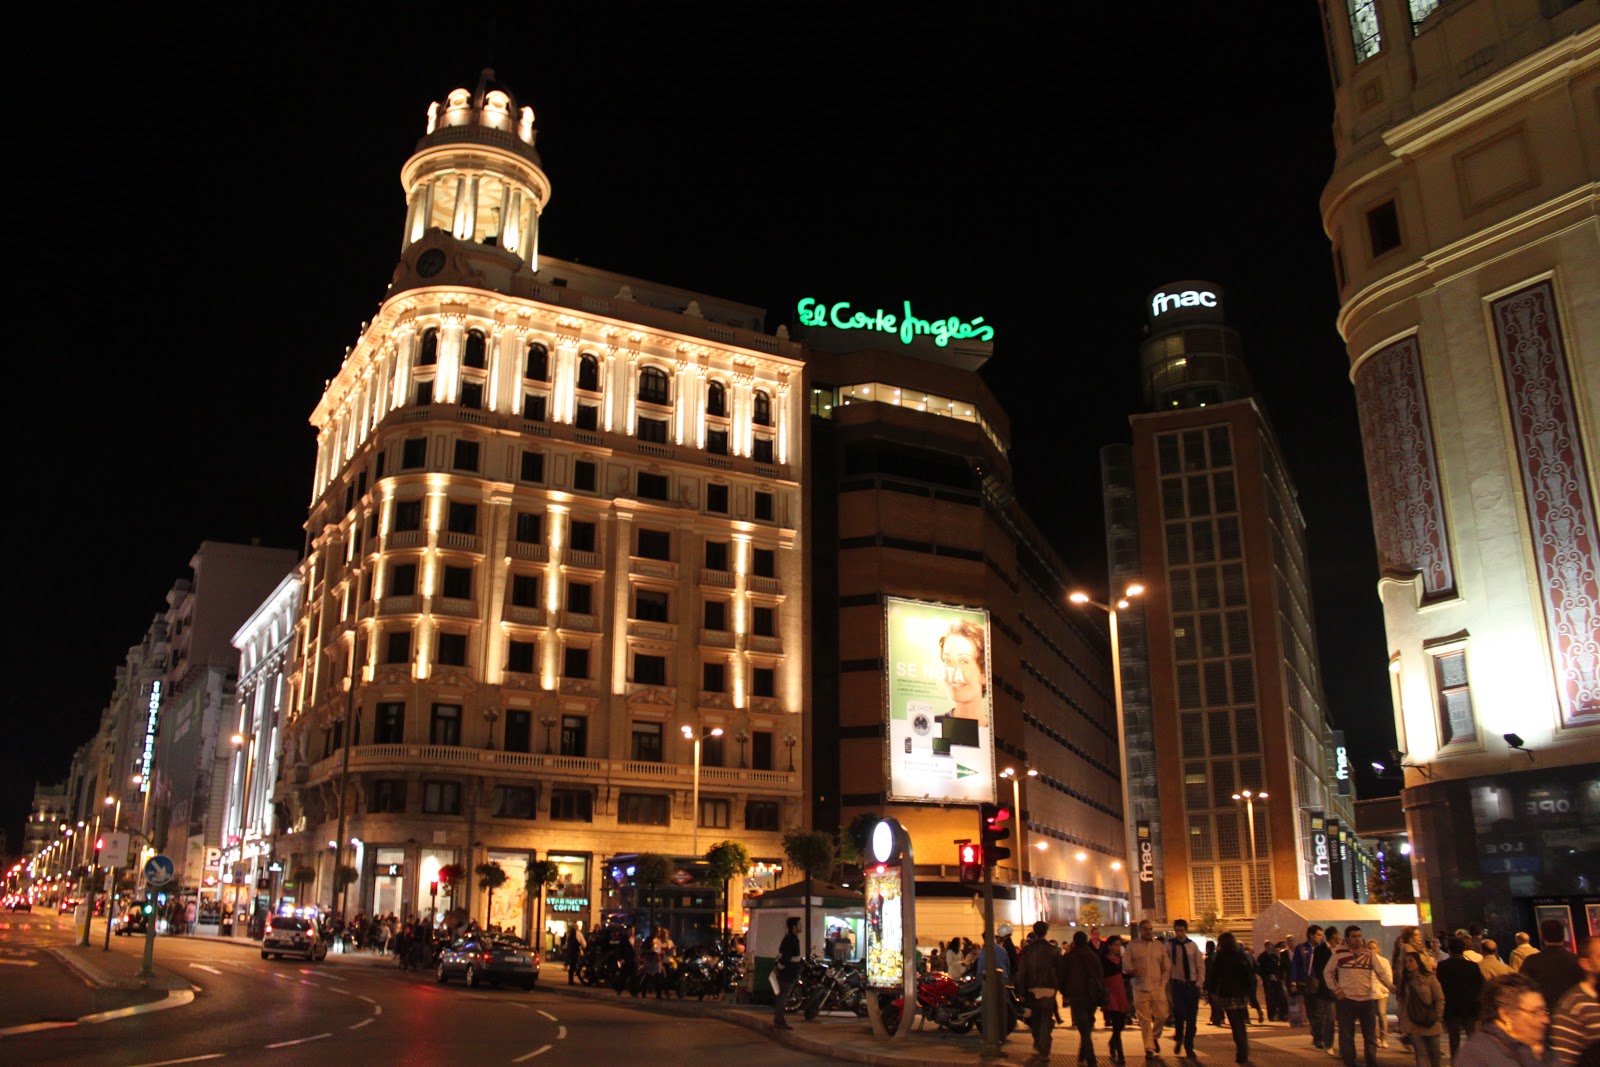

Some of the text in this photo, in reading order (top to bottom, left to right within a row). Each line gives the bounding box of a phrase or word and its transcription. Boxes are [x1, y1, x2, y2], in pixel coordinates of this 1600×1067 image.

[1152, 290, 1217, 316] fnac
[797, 297, 994, 347] El Corte Inglés
[896, 662, 917, 678] SE
[923, 665, 965, 683] NOTA
[147, 692, 160, 733] HOTEL
[1336, 747, 1347, 780] fnac
[1140, 842, 1154, 882] fnac
[1314, 834, 1329, 876] fnac
[546, 897, 588, 906] STARBUCKS
[553, 904, 581, 912] COFFEE
